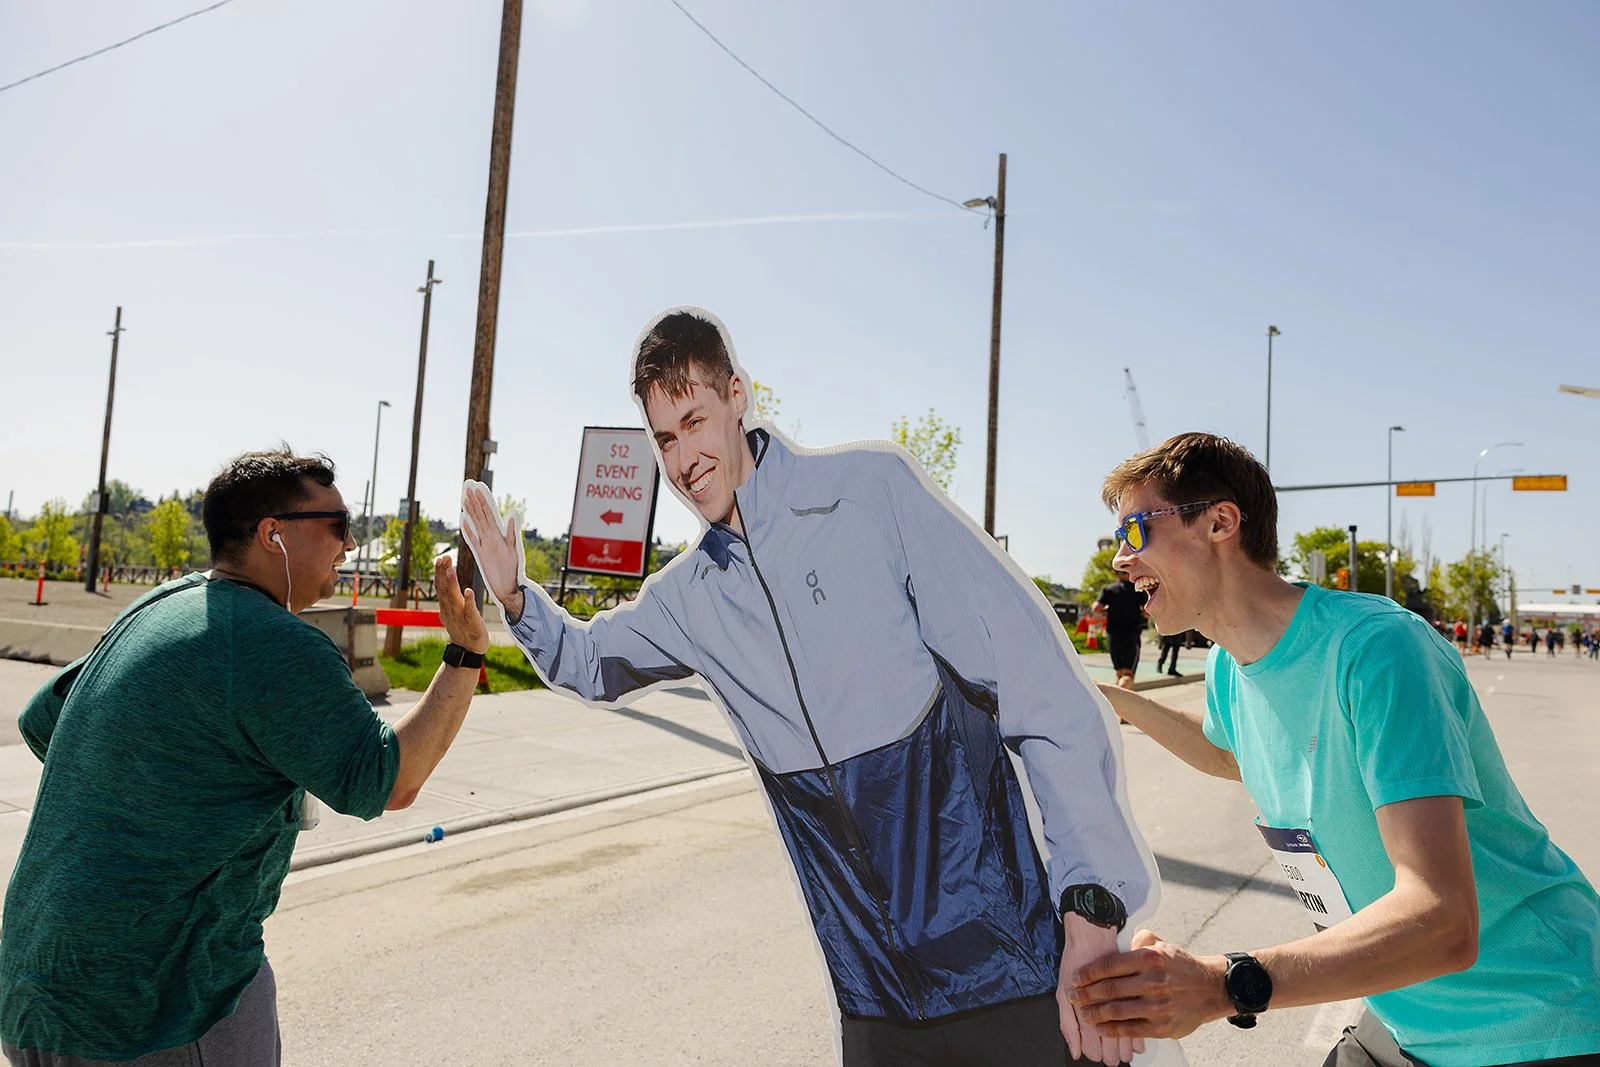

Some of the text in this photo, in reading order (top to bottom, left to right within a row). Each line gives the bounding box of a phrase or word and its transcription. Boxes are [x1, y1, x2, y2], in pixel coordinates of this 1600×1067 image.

[610, 443, 630, 459] $12
[595, 464, 639, 480] EVENT
[585, 482, 643, 501] PARKING
